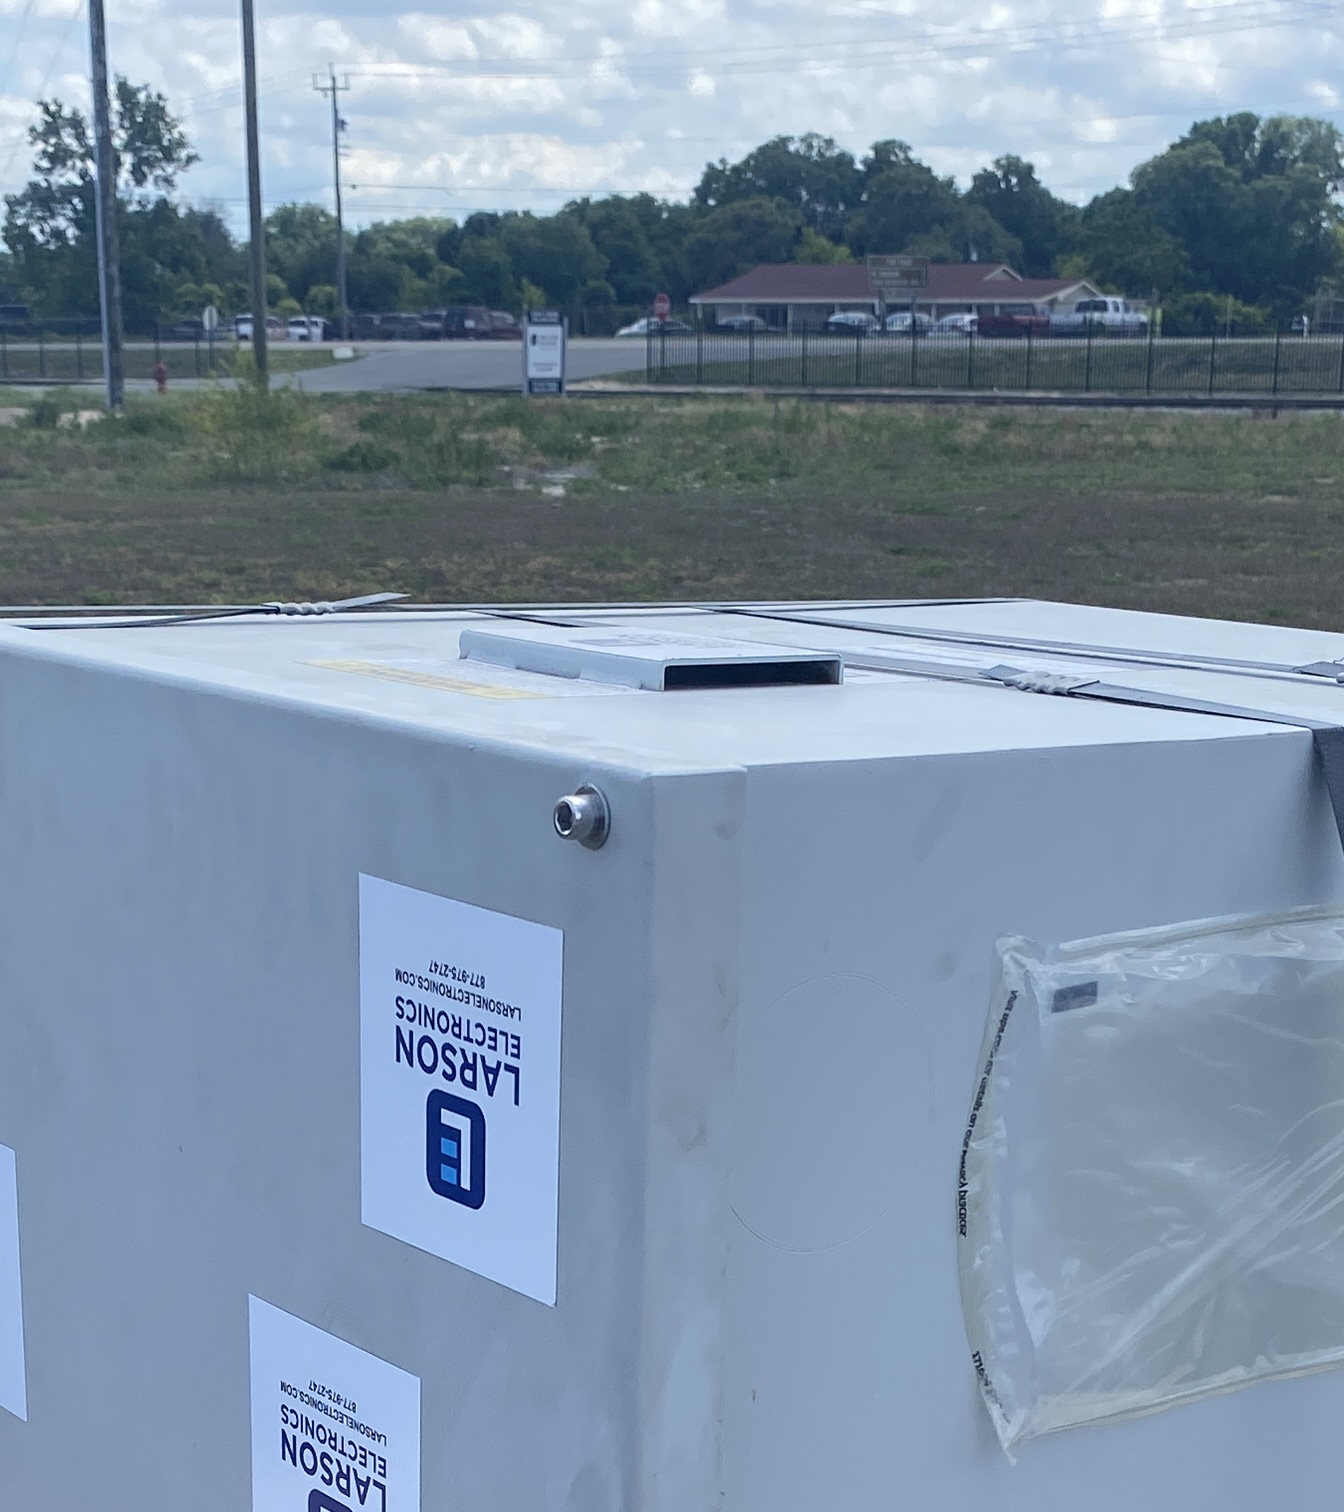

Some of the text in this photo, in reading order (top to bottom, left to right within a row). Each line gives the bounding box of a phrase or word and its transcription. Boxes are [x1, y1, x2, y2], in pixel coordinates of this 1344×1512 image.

[395, 968, 521, 1022] LARSONELECTRONICS.COM
[428, 959, 485, 989] 877-975-2747
[395, 995, 521, 1060] ELECTRONICS
[395, 1025, 520, 1106] LARSON
[280, 1380, 387, 1447] LARSONELECTRONICS.COM
[308, 1379, 357, 1413] 877-975-2747
[281, 1403, 387, 1479] ELECTRONICS
